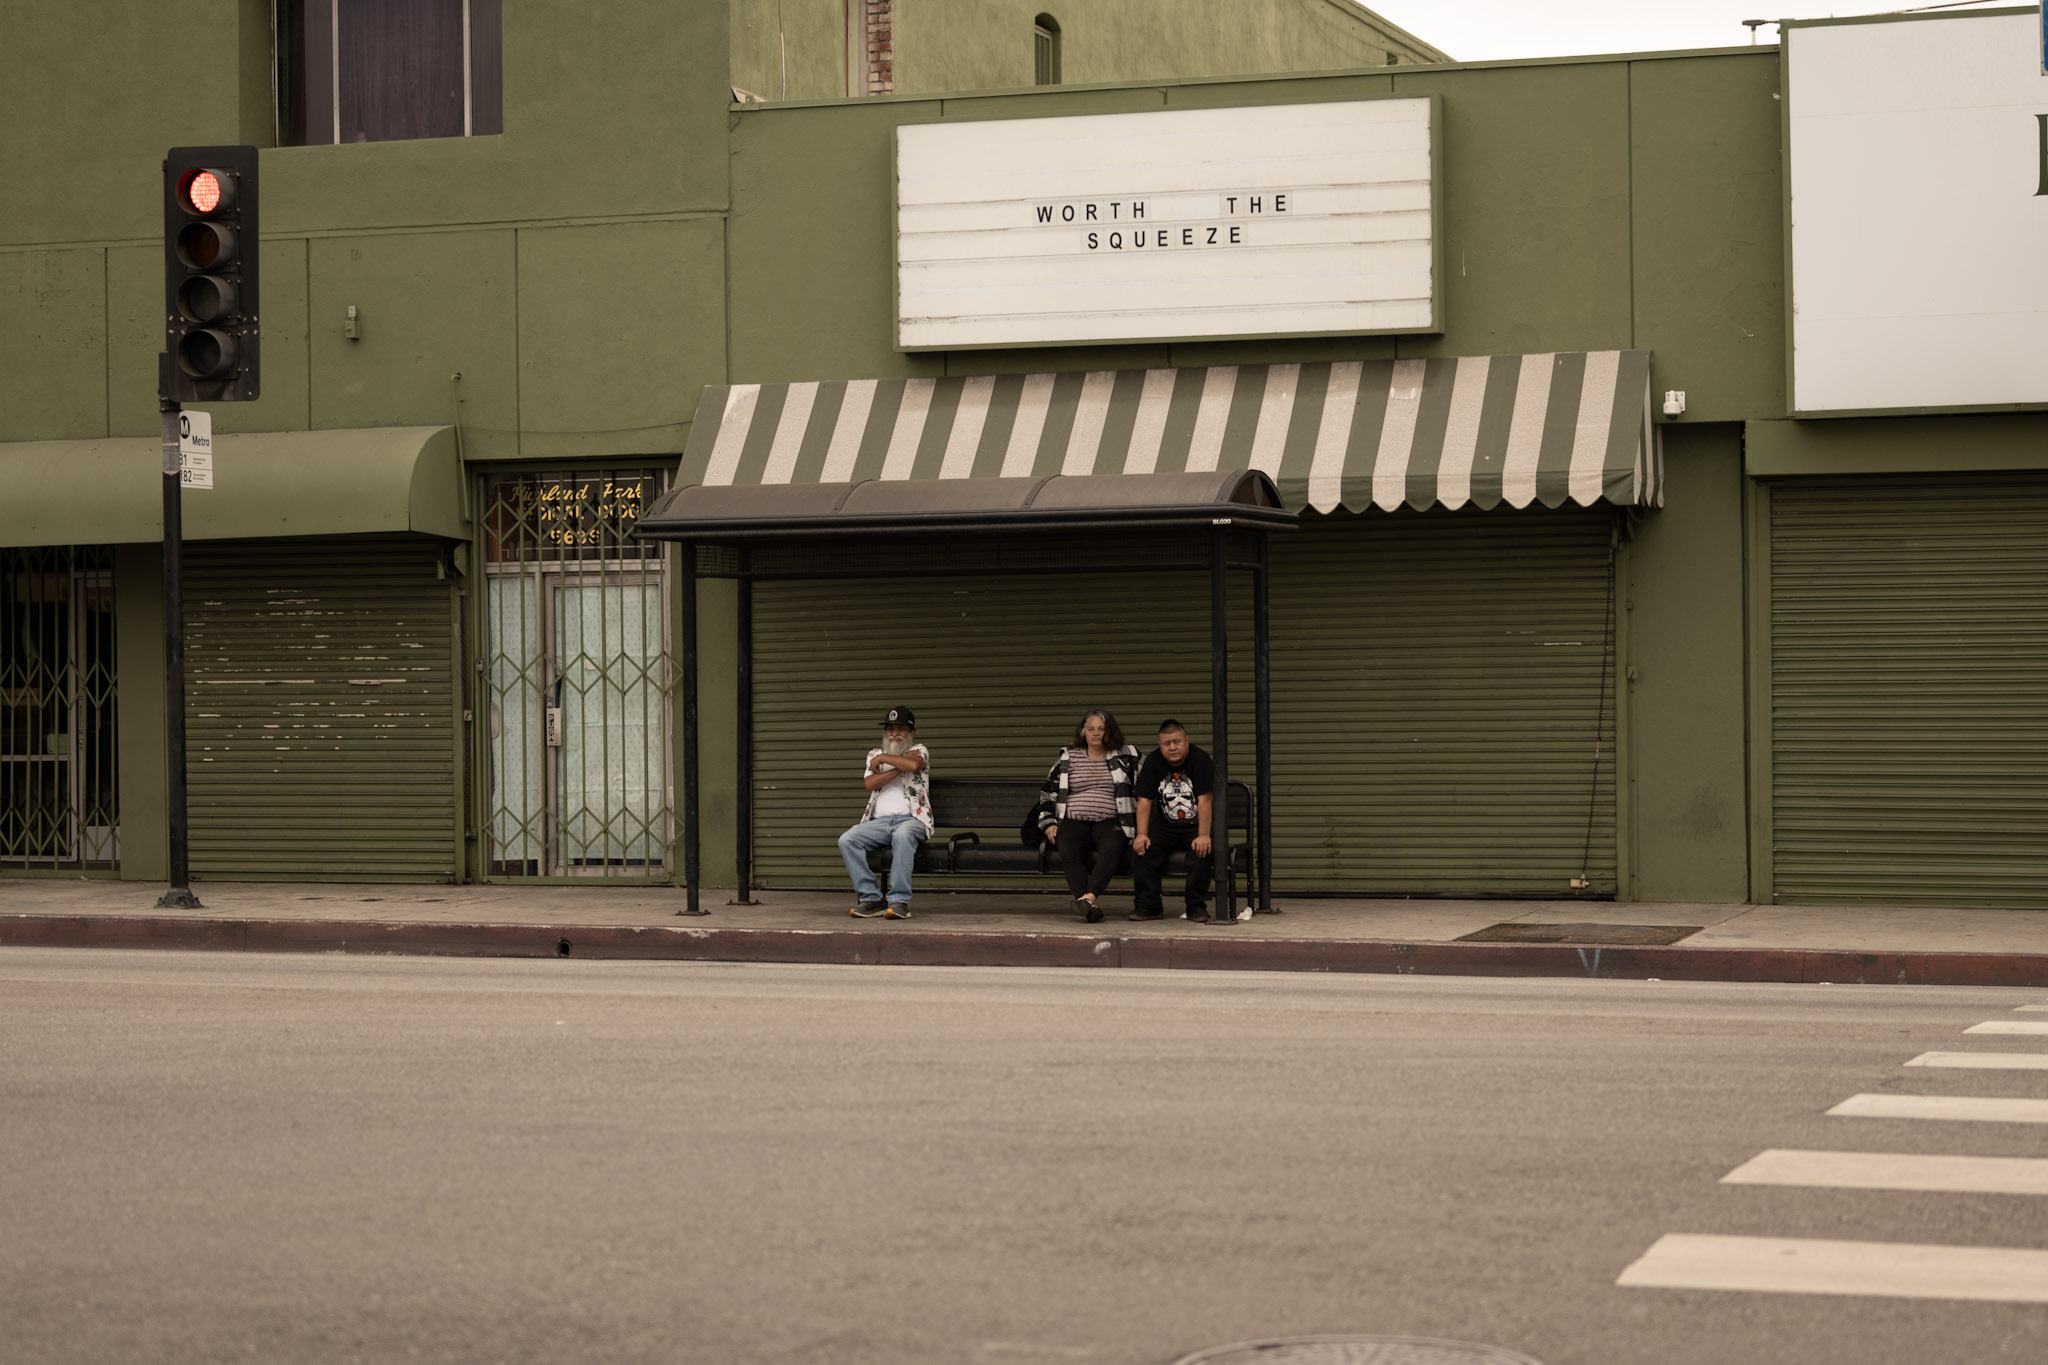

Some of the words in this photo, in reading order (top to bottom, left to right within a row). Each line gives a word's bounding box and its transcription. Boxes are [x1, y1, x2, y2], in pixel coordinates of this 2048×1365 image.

[1036, 202, 1145, 223] WORTH
[1226, 195, 1287, 215] THE
[1087, 227, 1241, 250] SQUEEZE
[192, 435, 210, 447] Metro
[515, 505, 585, 521] DICAL
